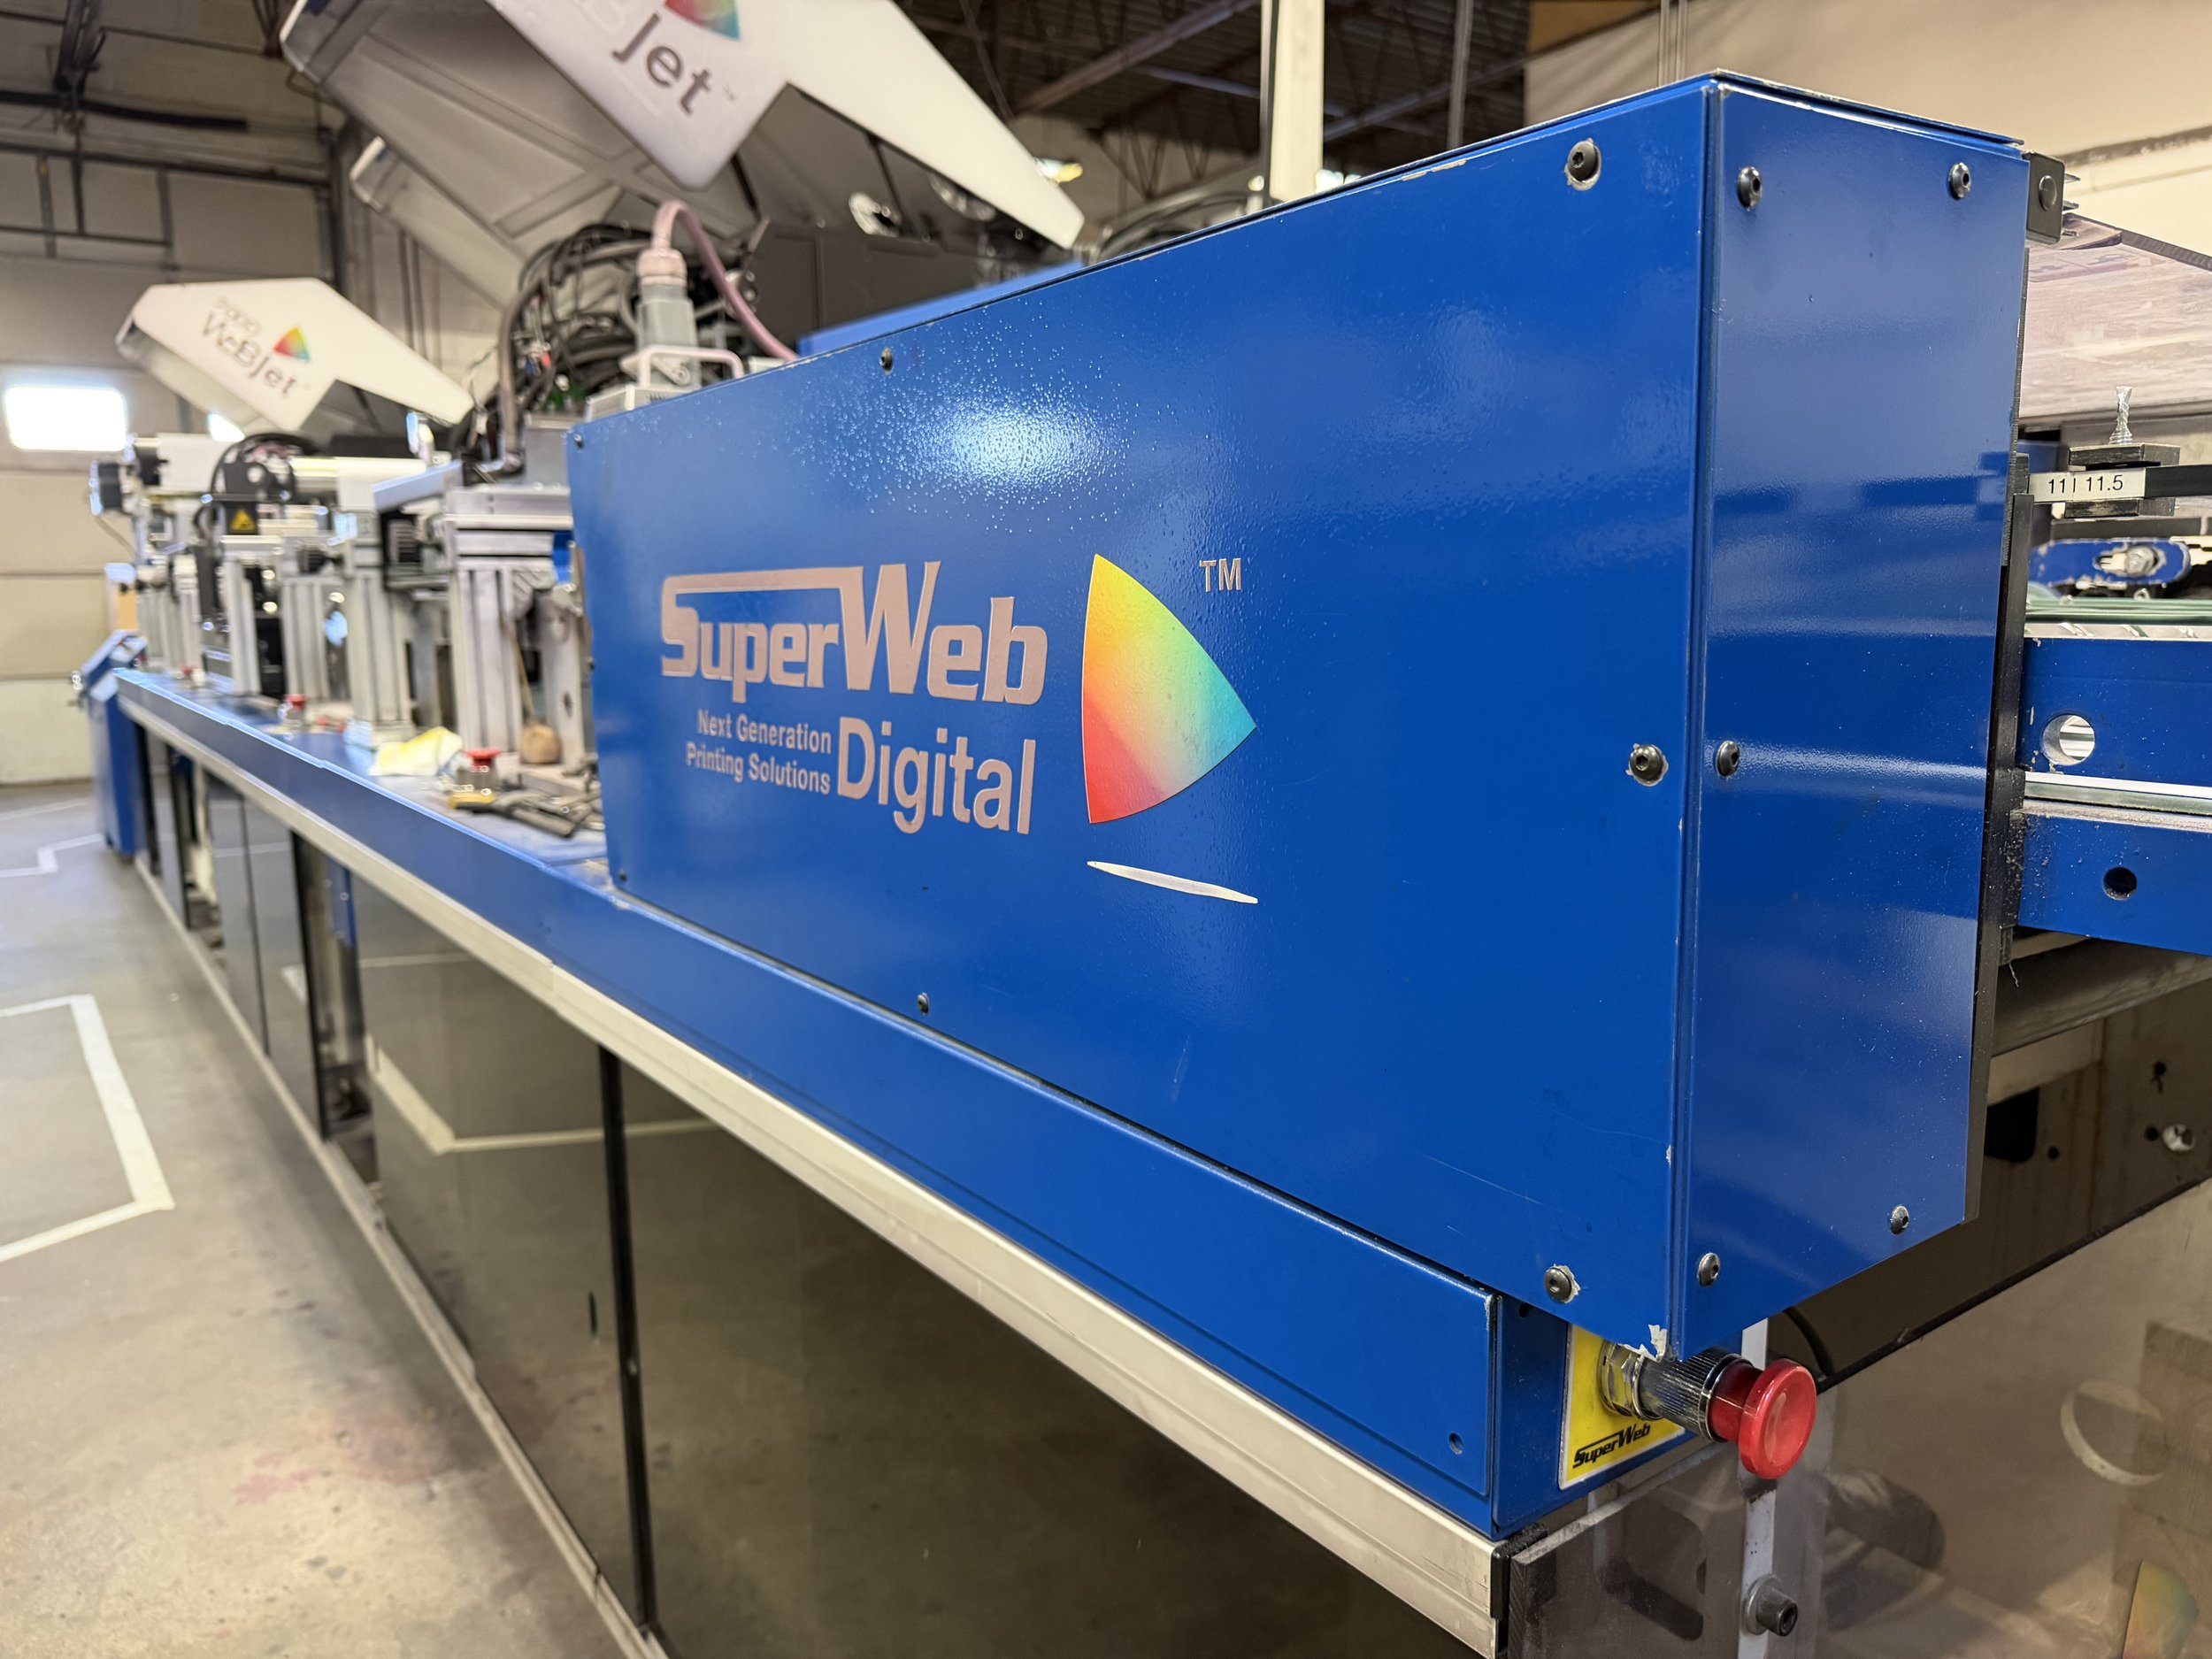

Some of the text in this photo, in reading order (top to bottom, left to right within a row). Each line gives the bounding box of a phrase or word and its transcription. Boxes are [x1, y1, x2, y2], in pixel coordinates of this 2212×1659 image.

[2048, 474, 2123, 494] 11 11.5
[1199, 557, 1241, 593] TM
[661, 561, 1048, 705] SuperWeb
[698, 709, 831, 754] Next Generation
[686, 741, 831, 795] Printing Solutions
[837, 716, 1036, 834] Digital
[1572, 1423, 1651, 1469] SuperWeb
